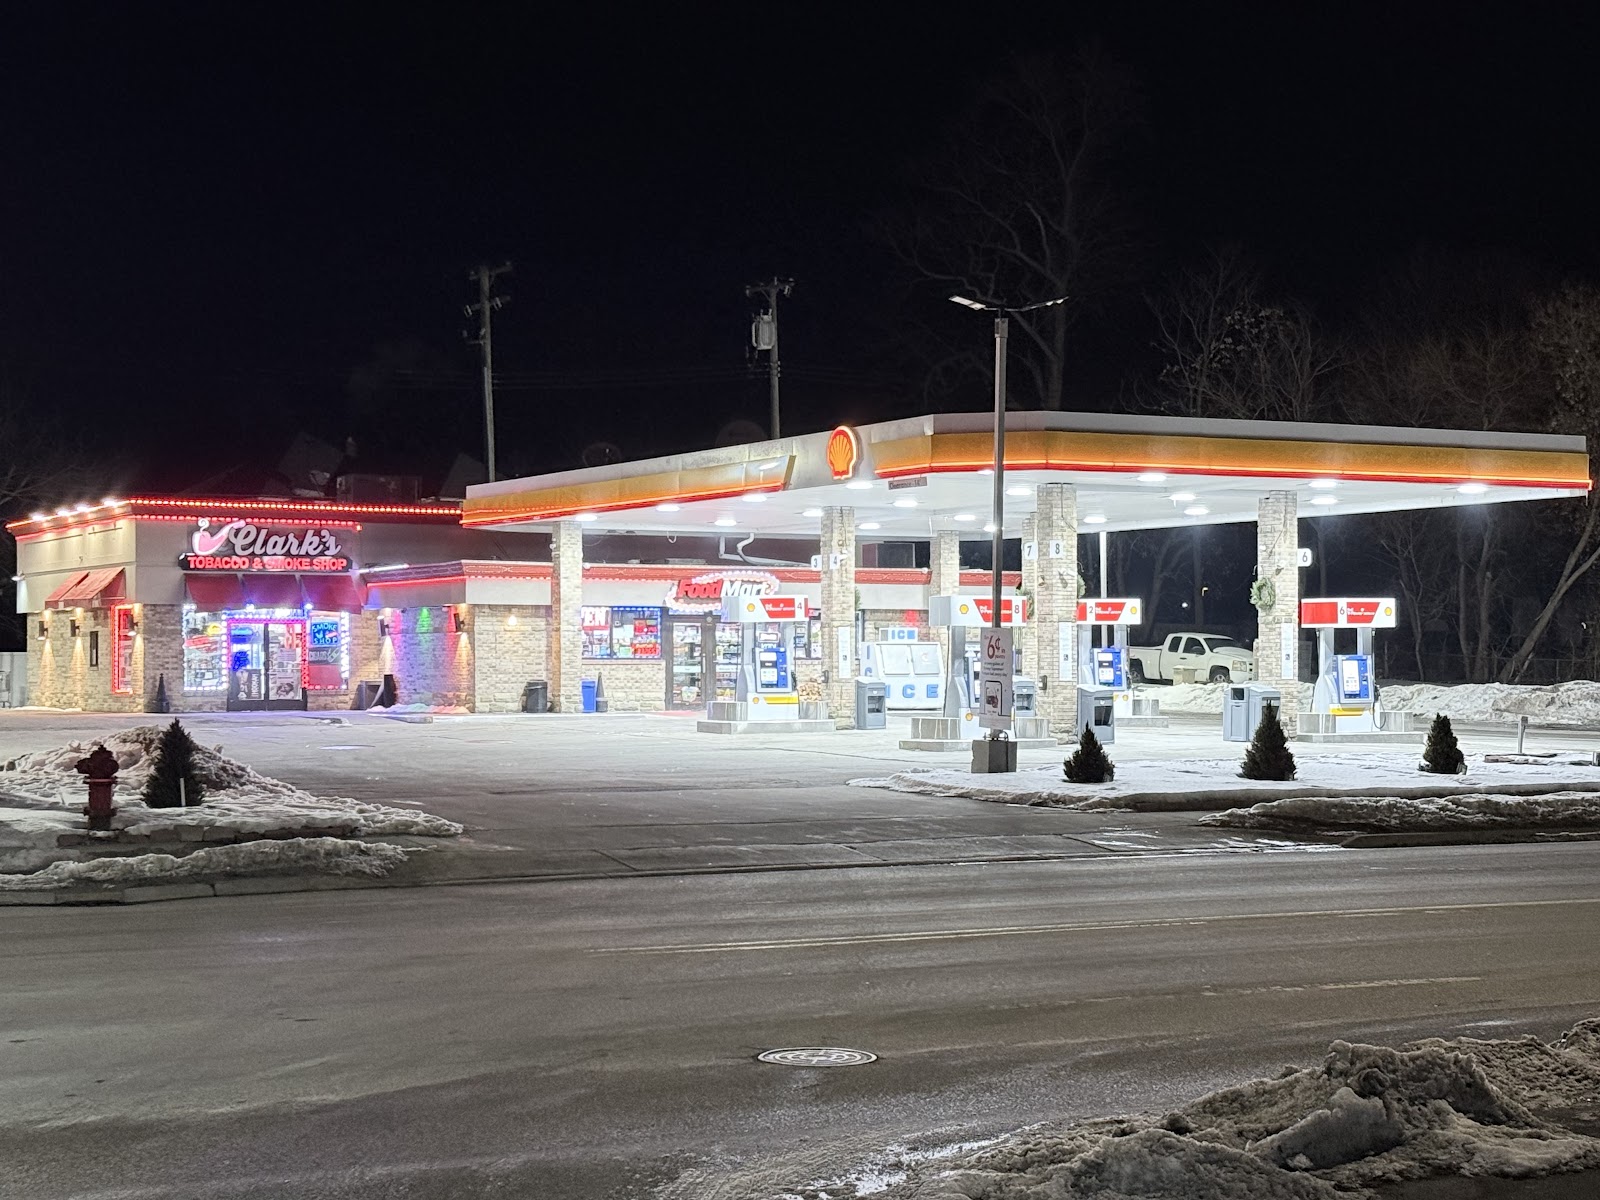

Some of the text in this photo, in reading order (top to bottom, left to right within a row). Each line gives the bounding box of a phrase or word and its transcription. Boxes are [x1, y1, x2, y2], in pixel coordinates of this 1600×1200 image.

[228, 524, 341, 555] Clark's
[1027, 545, 1032, 557] 7
[1055, 543, 1060, 554] 8
[833, 556, 838, 565] 4
[1302, 552, 1308, 562] 6
[187, 556, 347, 571] TOBACCO & SMOKE SHOP
[813, 558, 818, 568] 3
[797, 602, 802, 610] 4
[1014, 605, 1020, 614] 8
[1088, 606, 1094, 614] 2
[1340, 606, 1345, 615] 6
[312, 622, 337, 632] SMOKE
